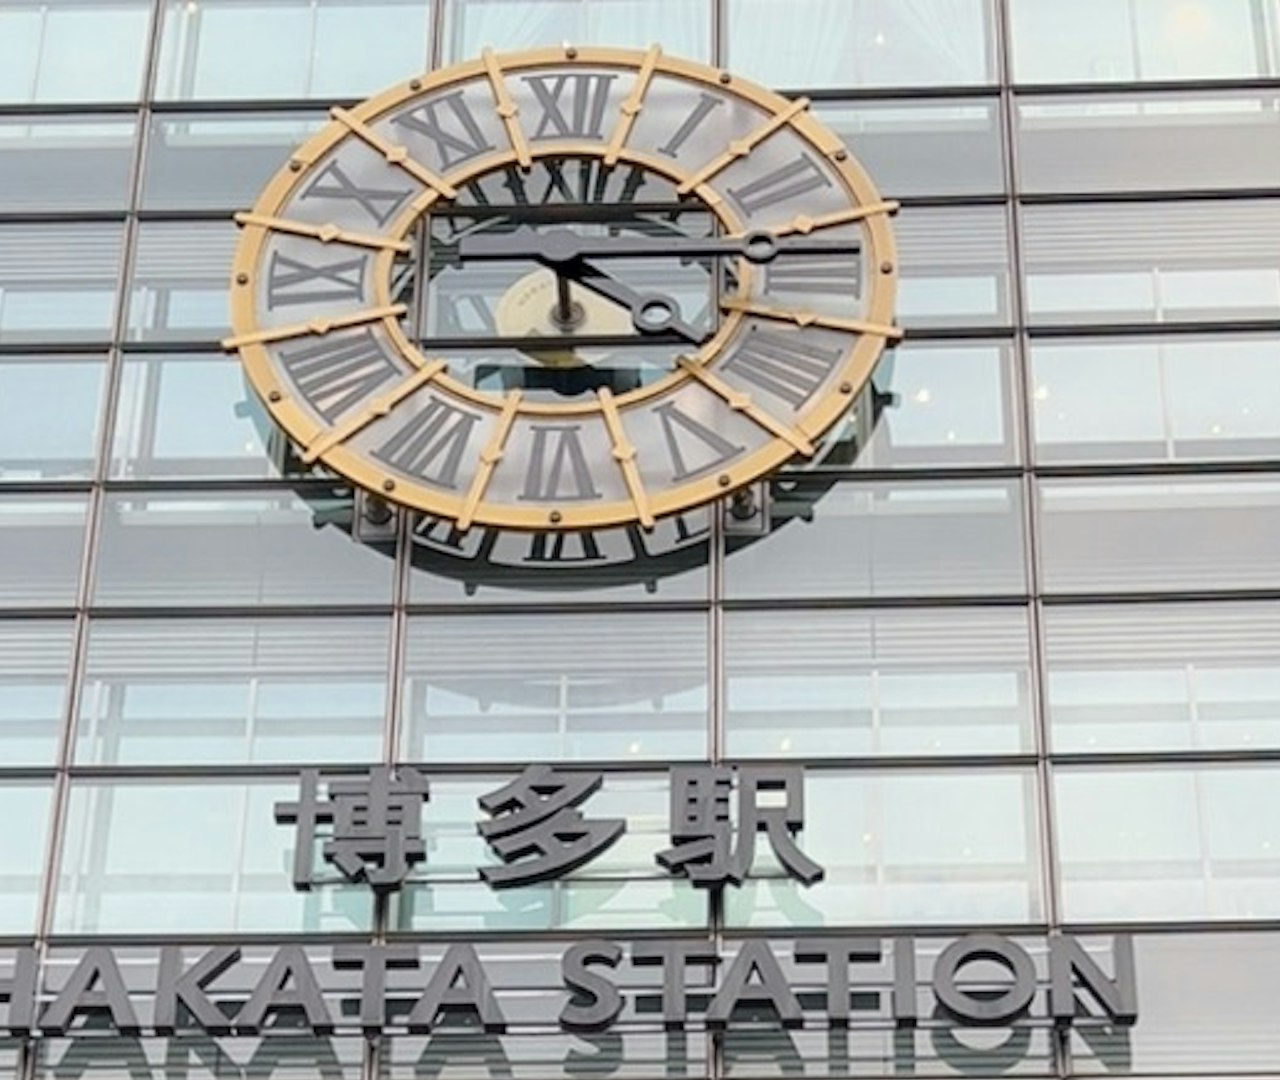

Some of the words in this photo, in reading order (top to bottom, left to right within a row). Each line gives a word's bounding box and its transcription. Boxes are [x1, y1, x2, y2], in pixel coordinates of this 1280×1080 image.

[390, 90, 496, 172] XI
[521, 74, 618, 141] XII
[658, 92, 724, 158] I
[300, 159, 414, 228] X
[727, 152, 832, 218] II
[268, 249, 368, 311] IX
[279, 326, 402, 427] VIII
[369, 395, 482, 490] VII
[517, 425, 602, 500] VI
[652, 402, 746, 482] V
[274, 765, 825, 891] 博多駅
[558, 934, 1138, 1032] STATION
